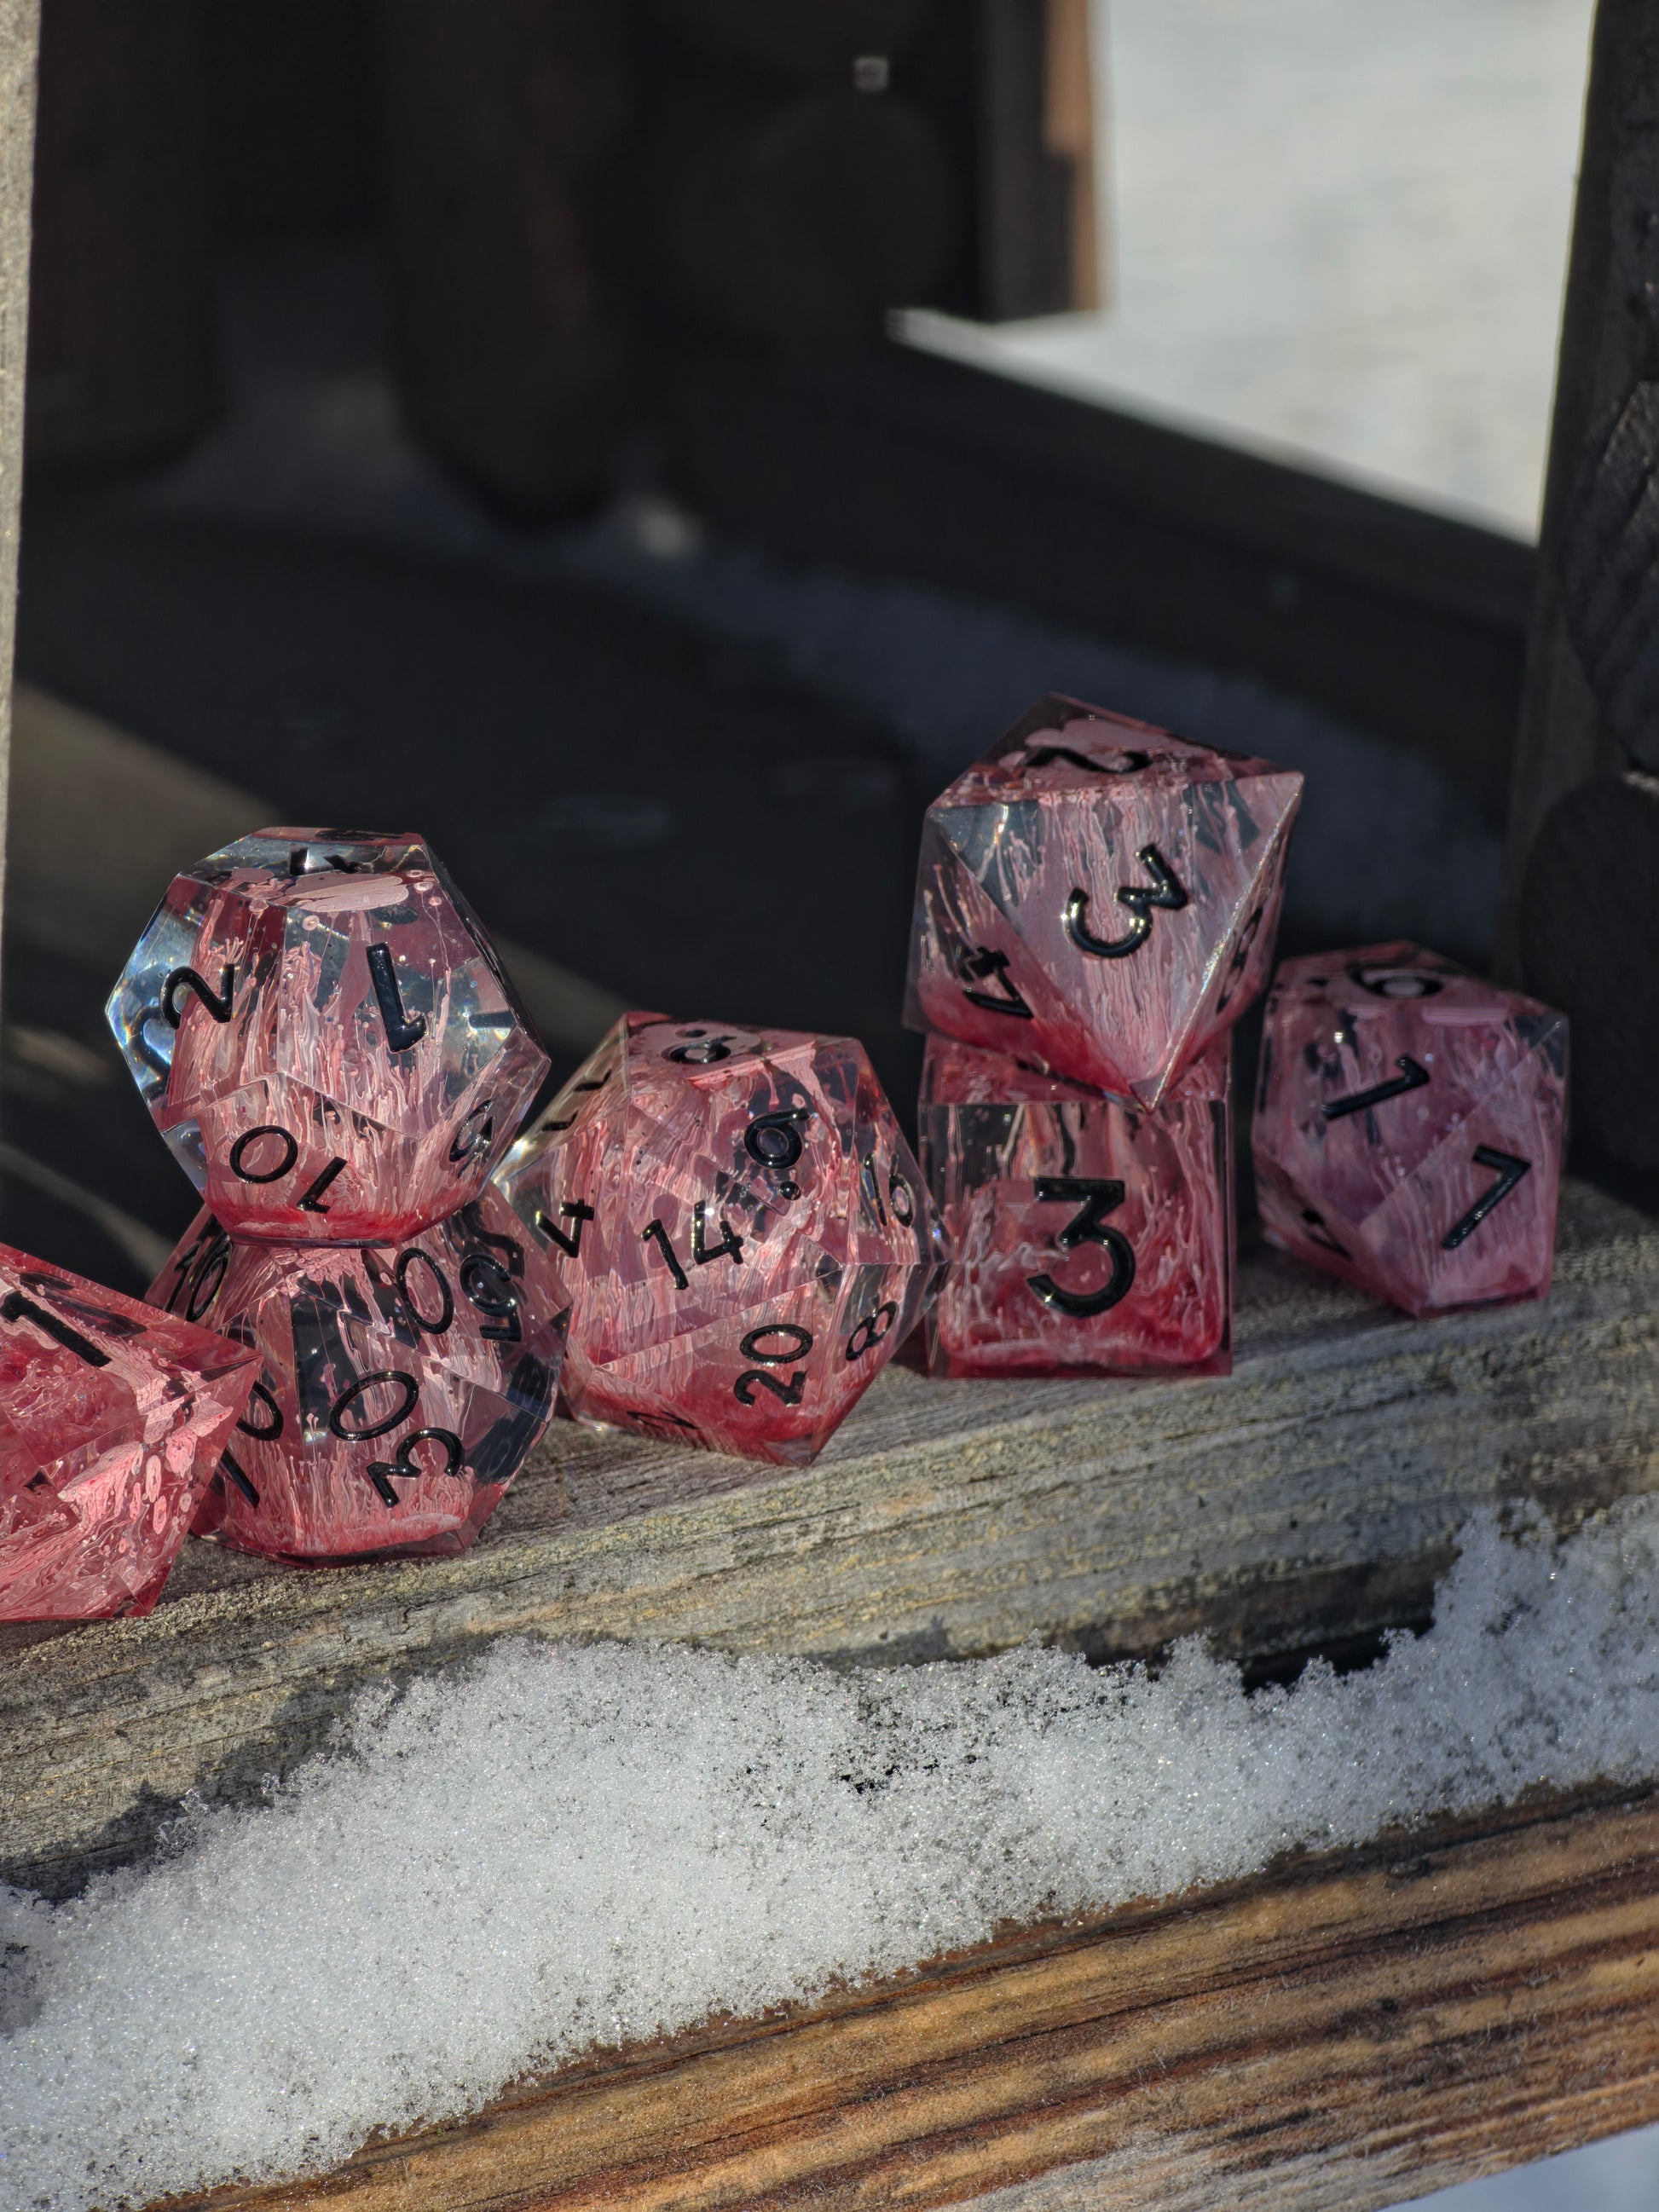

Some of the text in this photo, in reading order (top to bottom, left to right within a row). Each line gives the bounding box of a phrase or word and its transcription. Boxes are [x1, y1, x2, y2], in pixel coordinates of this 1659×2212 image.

[1026, 747, 1152, 773] 2
[1062, 843, 1189, 957] 3
[159, 963, 234, 1030] 2
[367, 941, 429, 1054] 1
[1321, 1054, 1431, 1121] 1
[229, 1124, 347, 1214] 10
[864, 1152, 914, 1227] 16
[1440, 1146, 1531, 1250] 7
[535, 1198, 595, 1259] 4
[641, 1199, 745, 1291] 14
[1026, 1175, 1136, 1319] 3
[0, 1290, 113, 1367] 1
[397, 1248, 523, 1343] 50
[845, 1300, 900, 1361] 8
[734, 1323, 814, 1407] 20
[329, 1369, 465, 1508] 30
